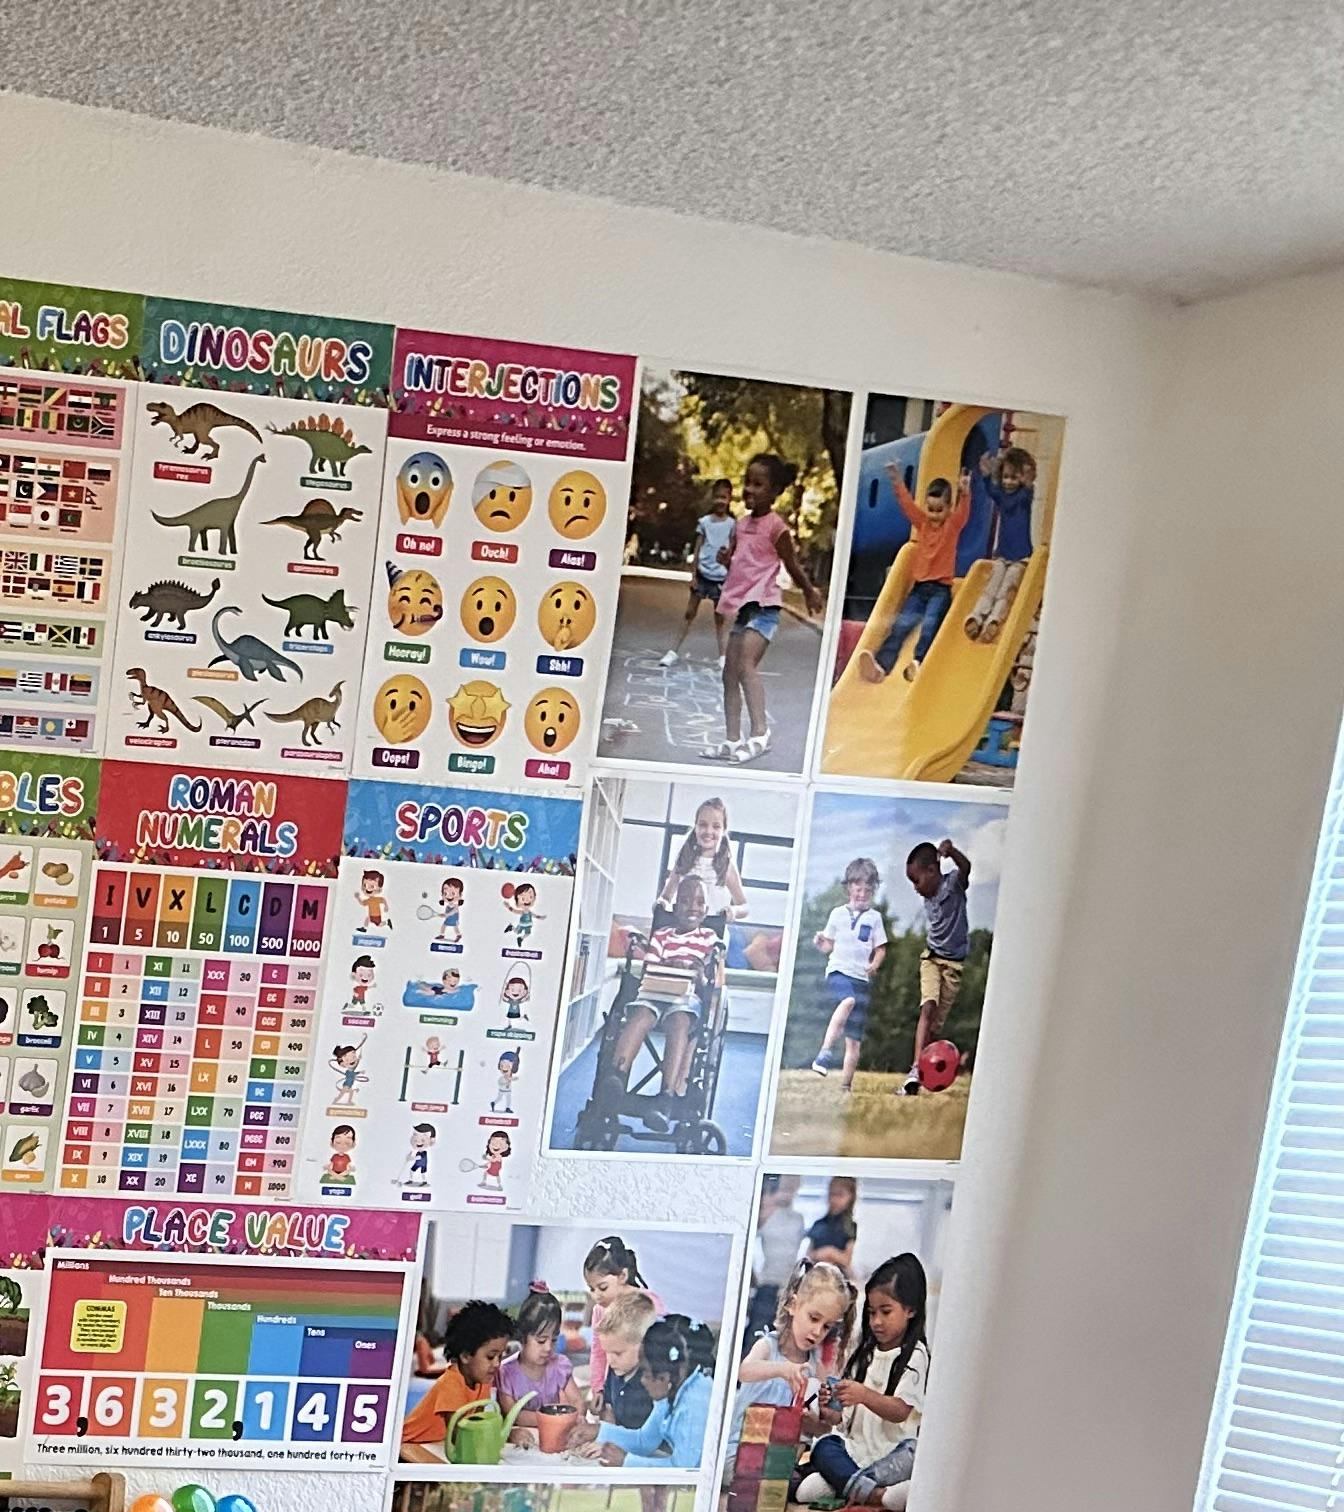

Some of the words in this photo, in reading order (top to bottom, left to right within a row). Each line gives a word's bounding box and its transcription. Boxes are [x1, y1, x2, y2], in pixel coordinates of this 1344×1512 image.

[36, 304, 129, 349] FLAGS
[160, 320, 372, 384] DINOSAURS
[404, 352, 621, 412] INTERJECTIONS
[168, 774, 277, 818] ROMAN
[136, 810, 299, 857] NUMERALS
[395, 801, 529, 852] SPORTS
[168, 888, 185, 911] X
[198, 932, 213, 945] 50
[229, 935, 249, 947] 100
[261, 936, 283, 949] 500
[292, 939, 320, 952] 1000
[122, 1206, 234, 1248] PLACE
[244, 1211, 350, 1251] VALUE
[37, 1443, 65, 1454] Three
[67, 1444, 102, 1456] million,
[105, 1445, 119, 1455] six
[121, 1445, 163, 1457] hundred
[165, 1446, 215, 1458] thirty-two
[217, 1447, 265, 1459] thousand,
[267, 1450, 285, 1459] one
[287, 1448, 327, 1460] hundred
[329, 1450, 377, 1462] forty-five
